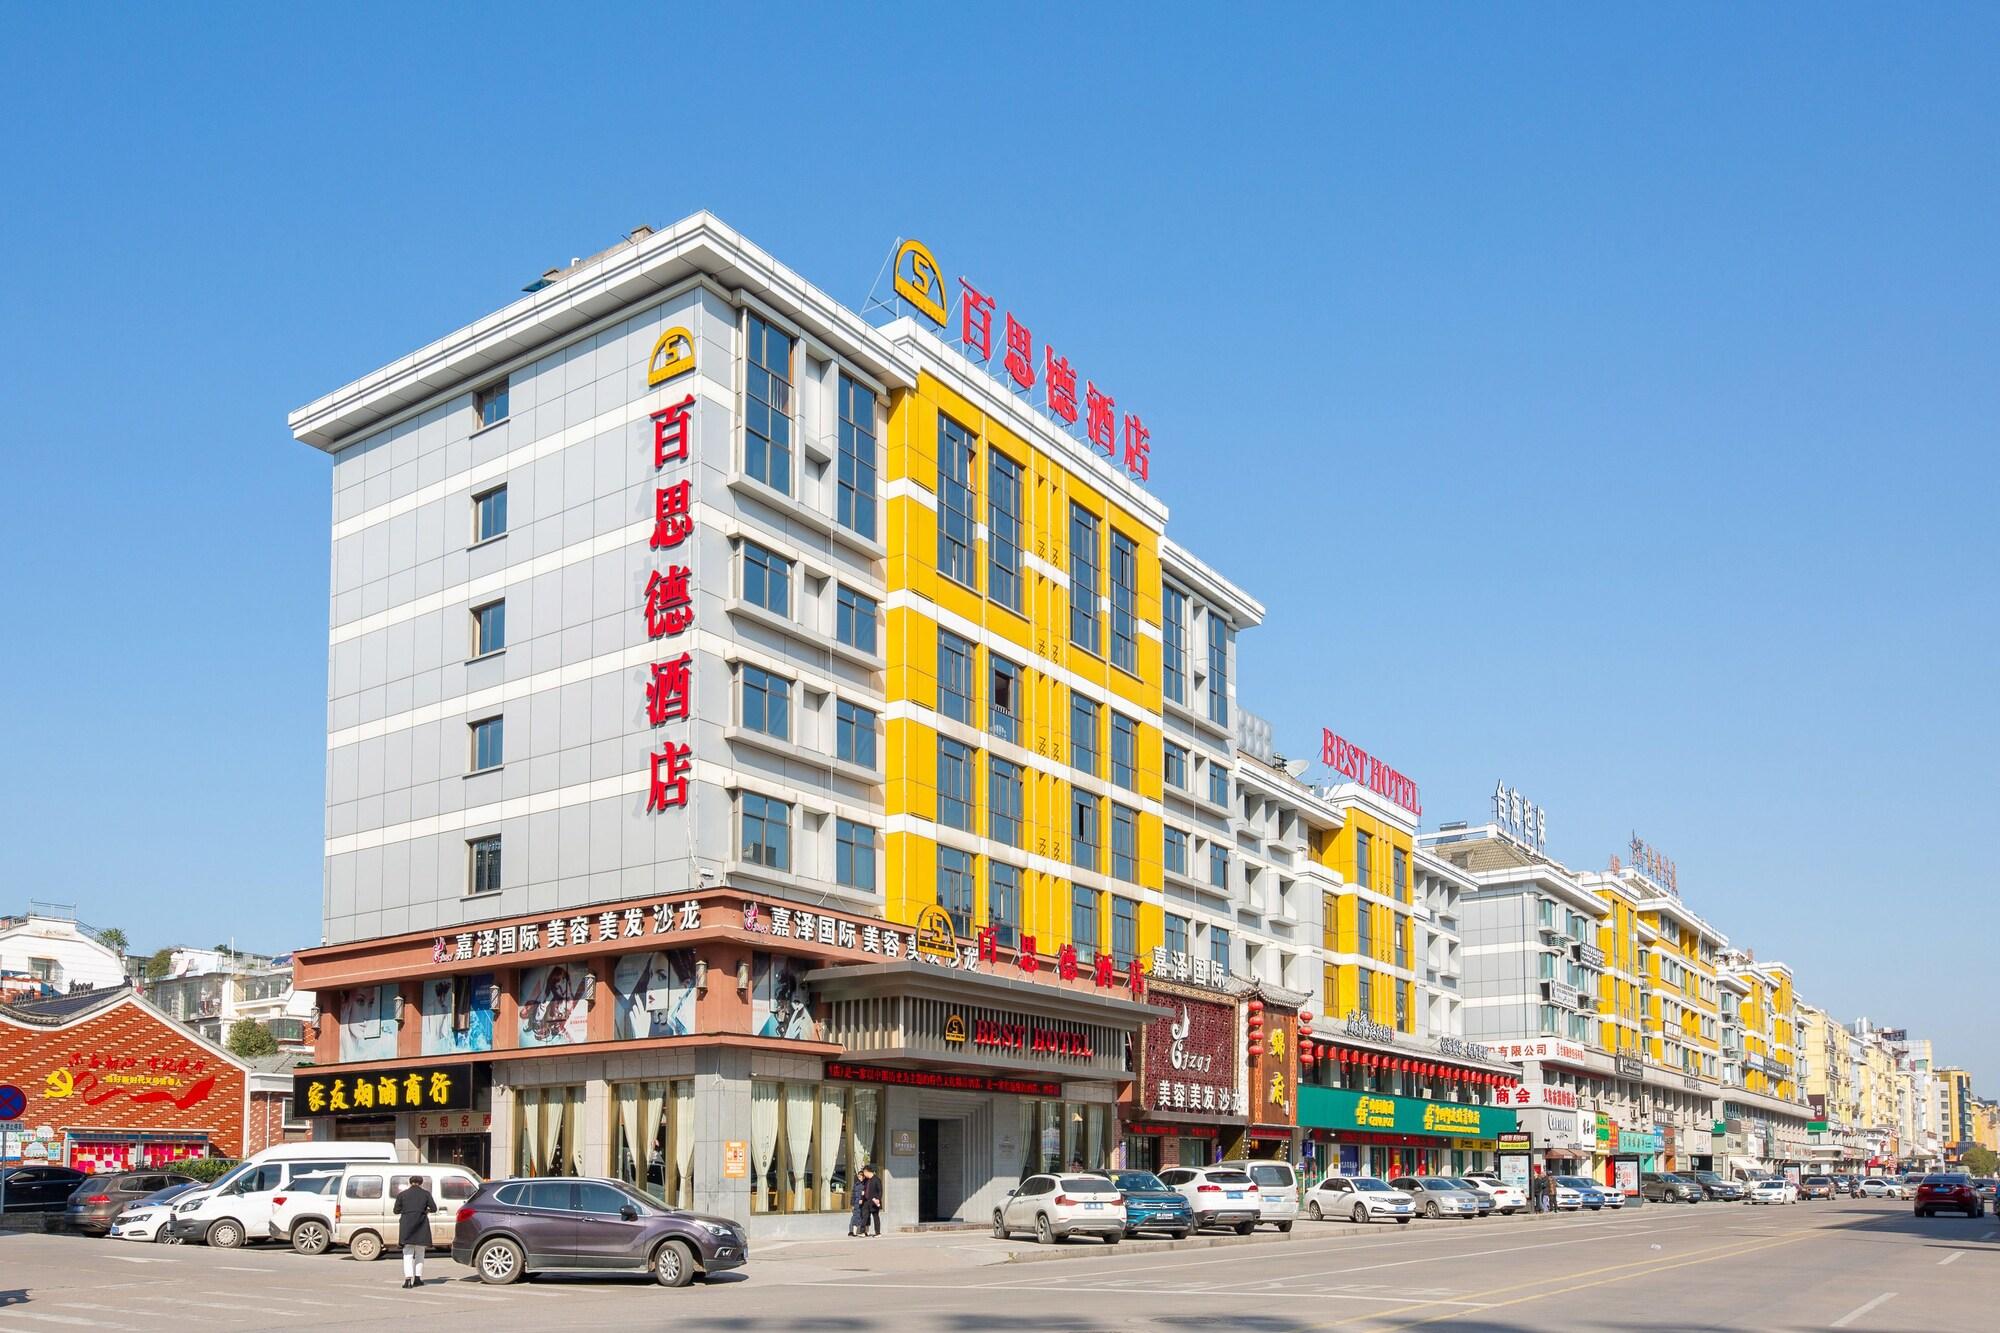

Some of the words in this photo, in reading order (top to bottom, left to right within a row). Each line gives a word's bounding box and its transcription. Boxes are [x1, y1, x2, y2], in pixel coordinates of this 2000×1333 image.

[958, 275, 1151, 483] 百思德酒店
[643, 394, 696, 813] 百思德酒店
[1322, 727, 1367, 785] BEST
[1369, 755, 1422, 817] HOTEL
[975, 925, 1145, 994] 百思德酒店
[1152, 945, 1226, 988] 嘉泽国际
[974, 1019, 1025, 1049] BEST
[1031, 1027, 1094, 1057] HOTEL
[1158, 1079, 1242, 1112] 美容美发沙龙
